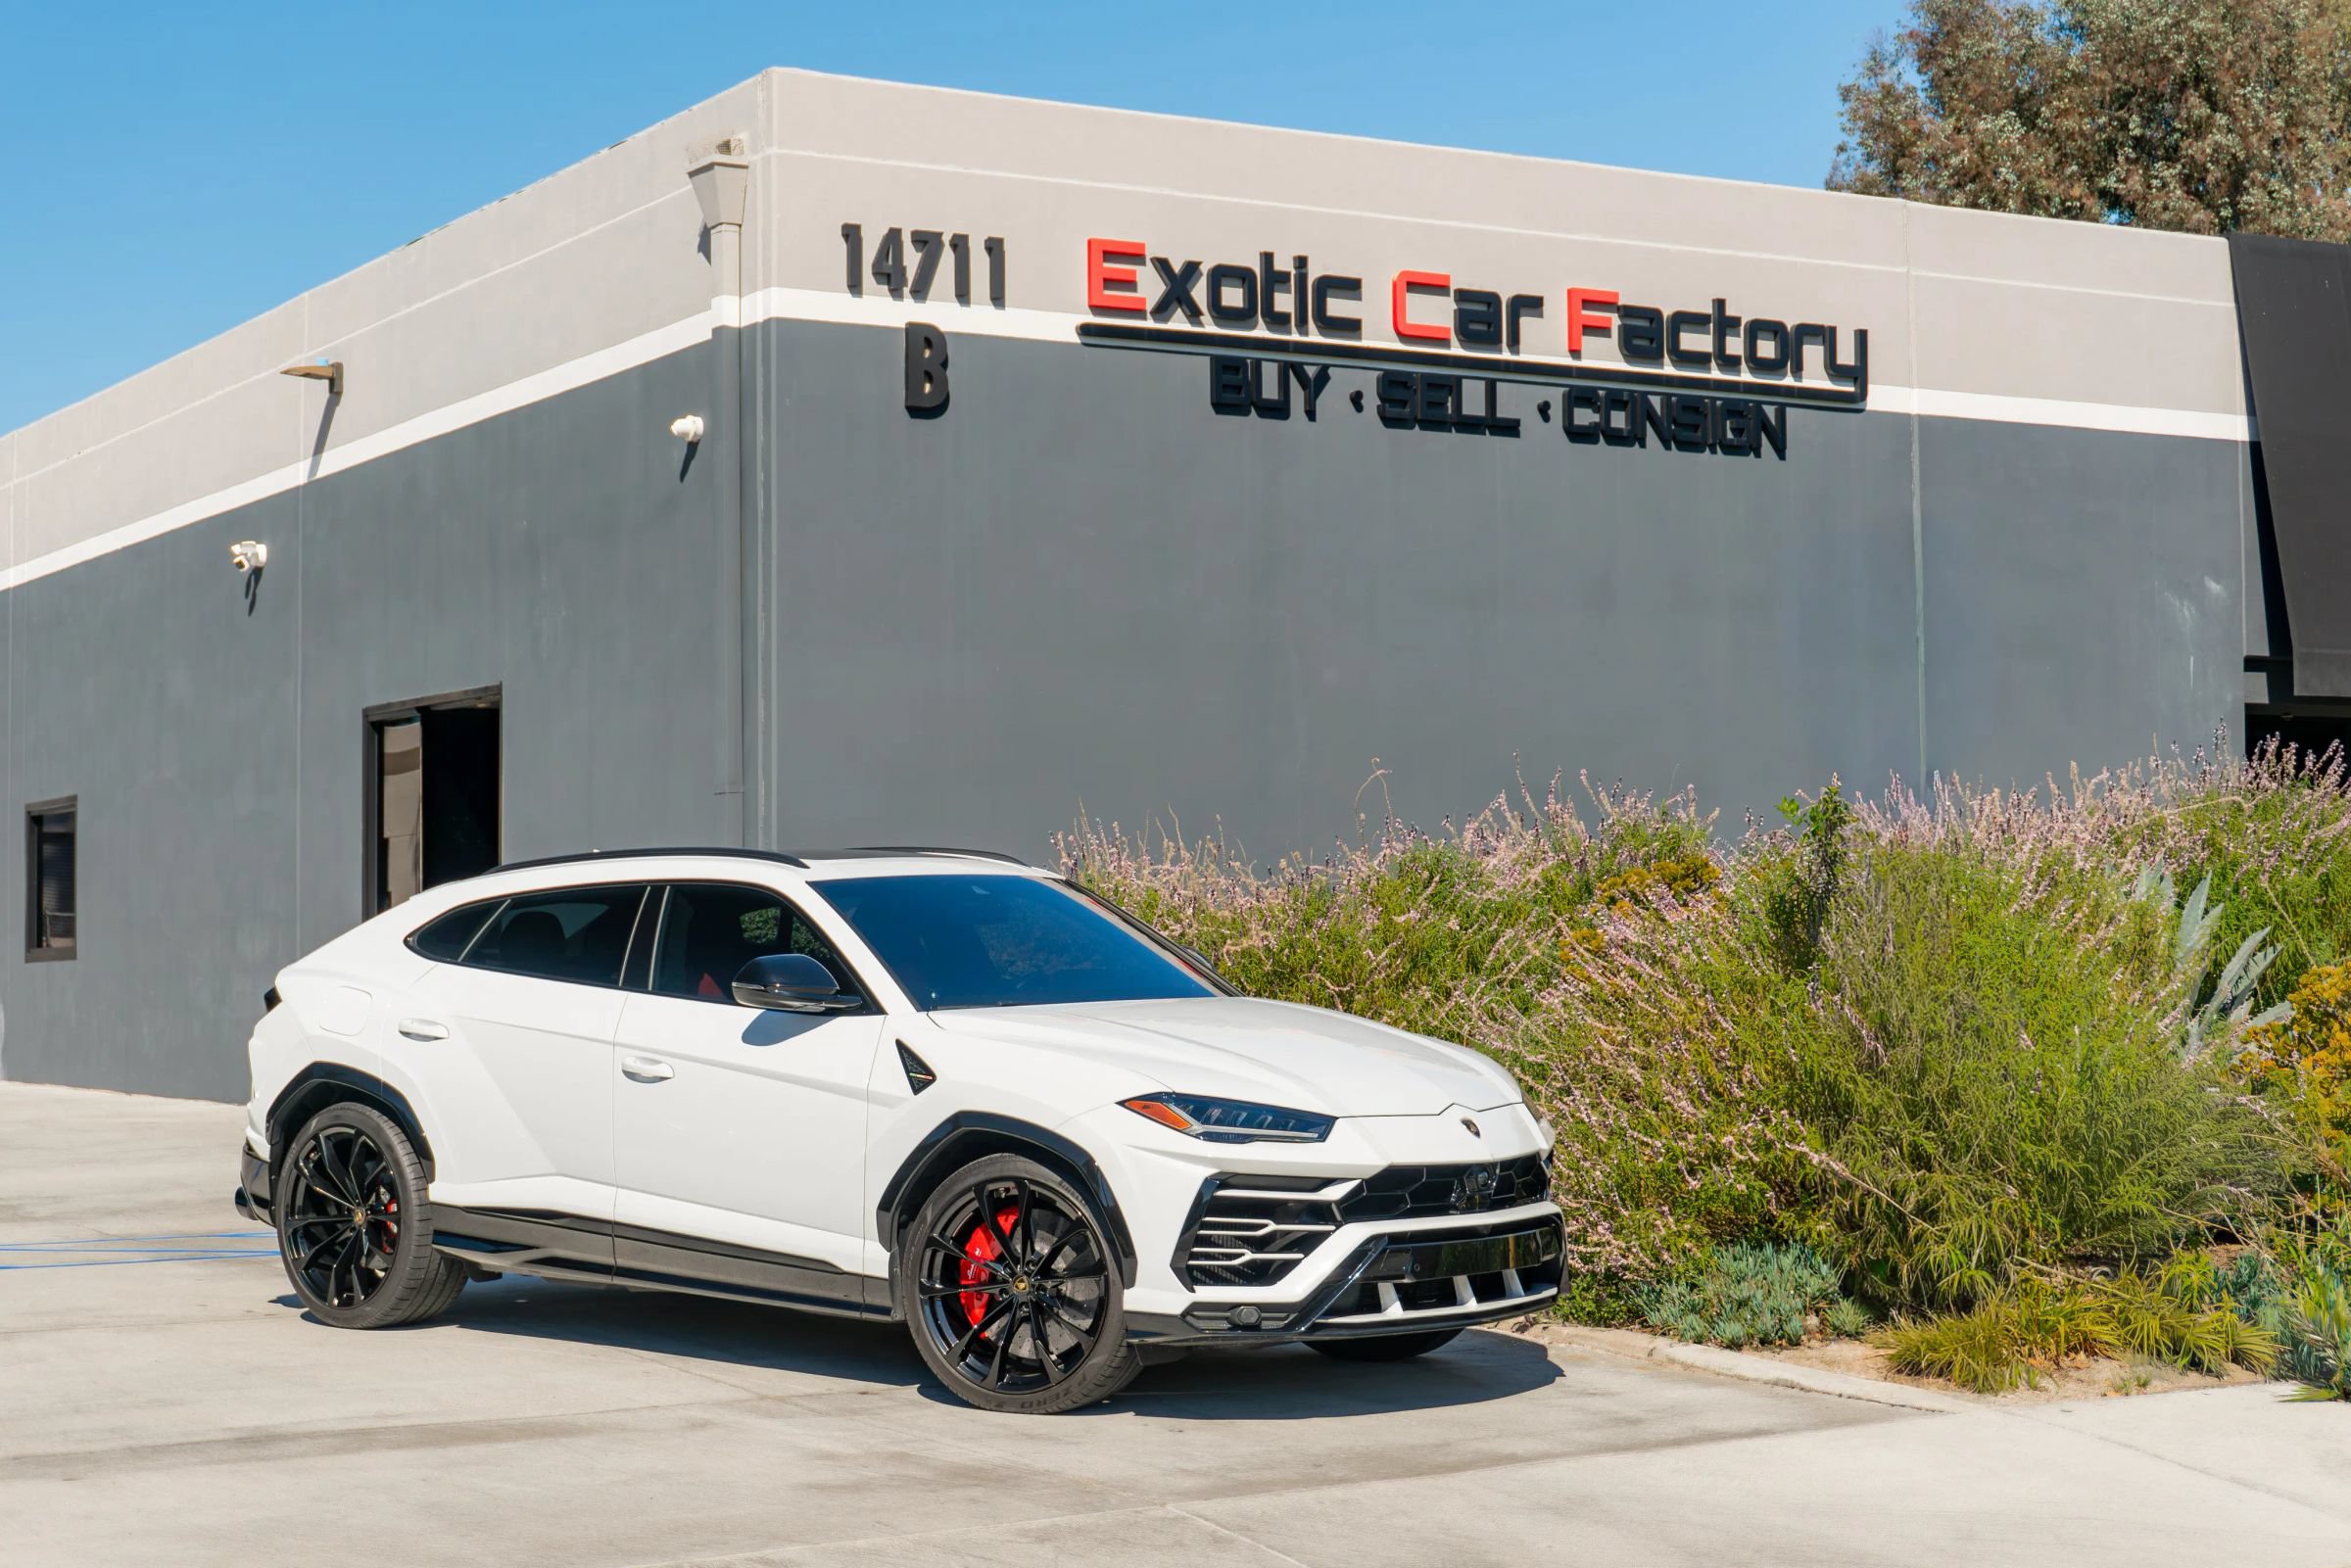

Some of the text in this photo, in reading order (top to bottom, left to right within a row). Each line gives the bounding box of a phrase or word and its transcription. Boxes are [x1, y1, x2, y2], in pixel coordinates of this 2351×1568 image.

[840, 222, 1005, 303] 14711
[904, 321, 948, 411] B
[1086, 237, 1869, 403] Exotic Car Factory
[1210, 355, 1787, 454] BUY SELL CONSIGN
